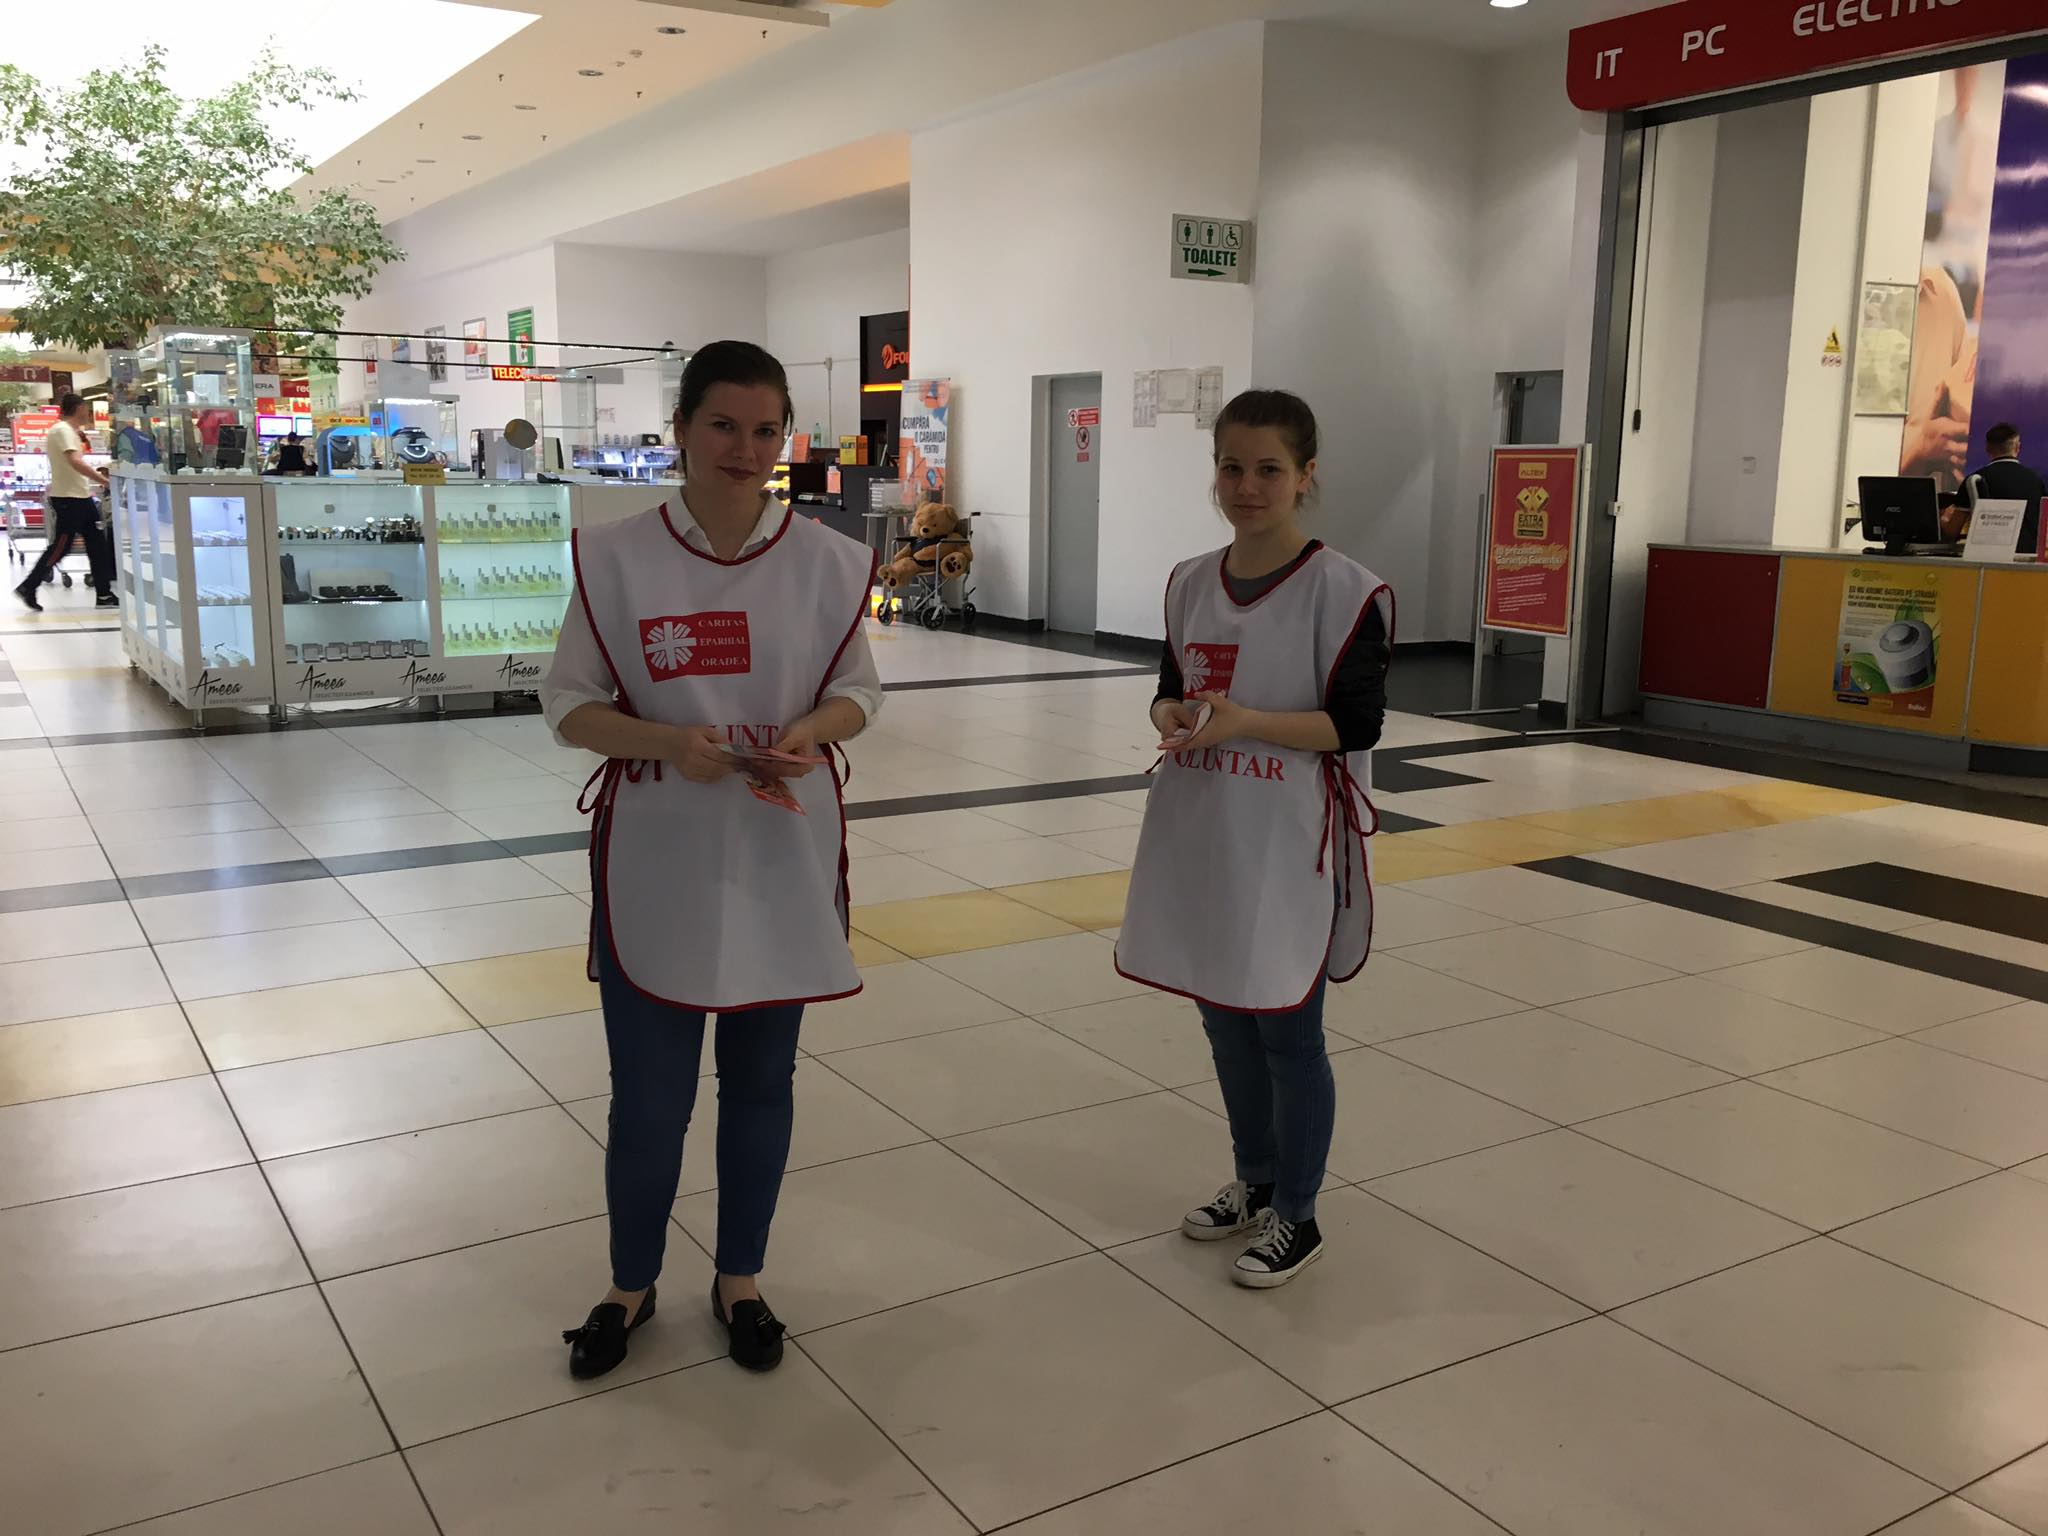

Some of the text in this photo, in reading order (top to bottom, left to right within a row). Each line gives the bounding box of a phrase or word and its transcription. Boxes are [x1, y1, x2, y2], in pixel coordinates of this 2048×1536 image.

[1595, 47, 1623, 79] IT
[1681, 25, 1726, 61] PC
[1183, 247, 1237, 266] TOALETE
[1519, 513, 1544, 522] EXTRA
[698, 619, 746, 628] CARITAS
[700, 636, 748, 646] EPARHIAL
[496, 654, 541, 688] Ameea
[701, 656, 748, 667] ORADEA
[189, 670, 243, 706] Ameea
[296, 665, 346, 700] Ameea
[399, 660, 447, 694] Ameea
